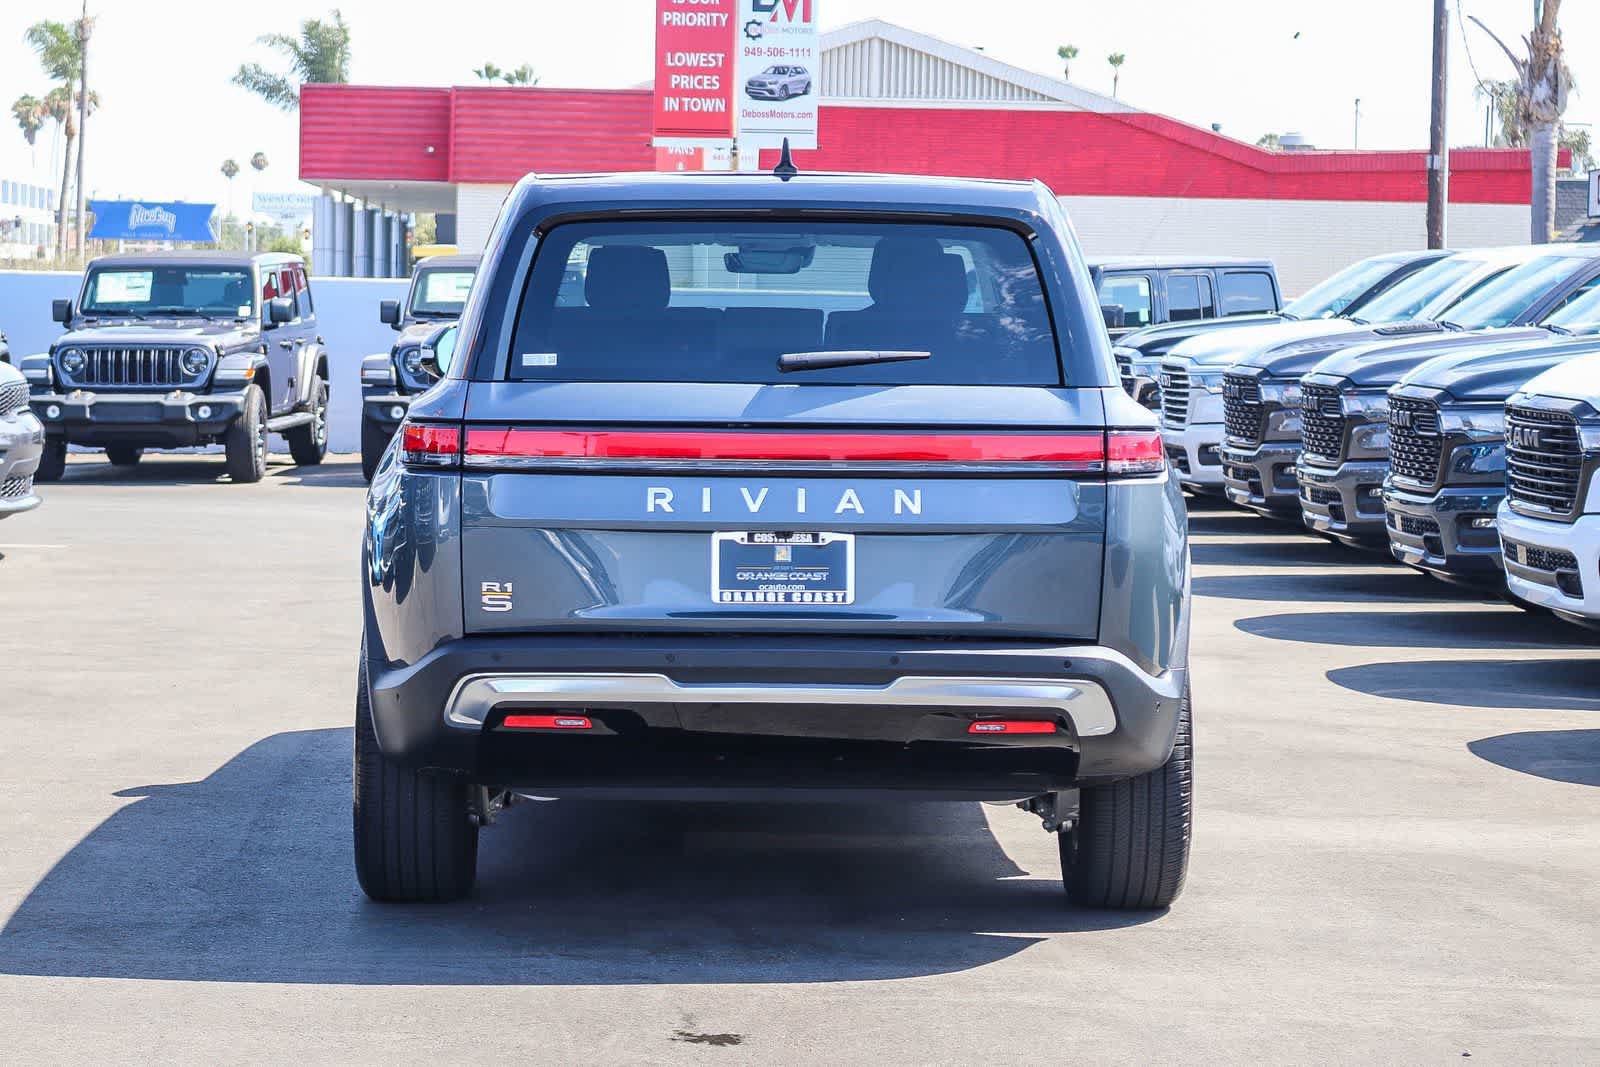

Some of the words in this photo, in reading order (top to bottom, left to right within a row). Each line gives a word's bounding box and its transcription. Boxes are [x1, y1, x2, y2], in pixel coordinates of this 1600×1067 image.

[662, 12, 729, 27] PRIORITY
[744, 46, 811, 57] 949-506-1111
[666, 52, 725, 67] LOWEST
[671, 75, 720, 90] PRICES
[664, 96, 679, 112] IN
[682, 97, 726, 112] TOWN
[742, 109, 813, 119] DebossMotors.com
[1504, 425, 1540, 448] RAM
[646, 487, 922, 515] RIVIAN
[736, 571, 788, 581] ORANGE
[789, 571, 829, 581] COAST
[758, 583, 806, 591] ocauto.com
[722, 592, 785, 603] ORANGE
[791, 592, 845, 603] COAST
